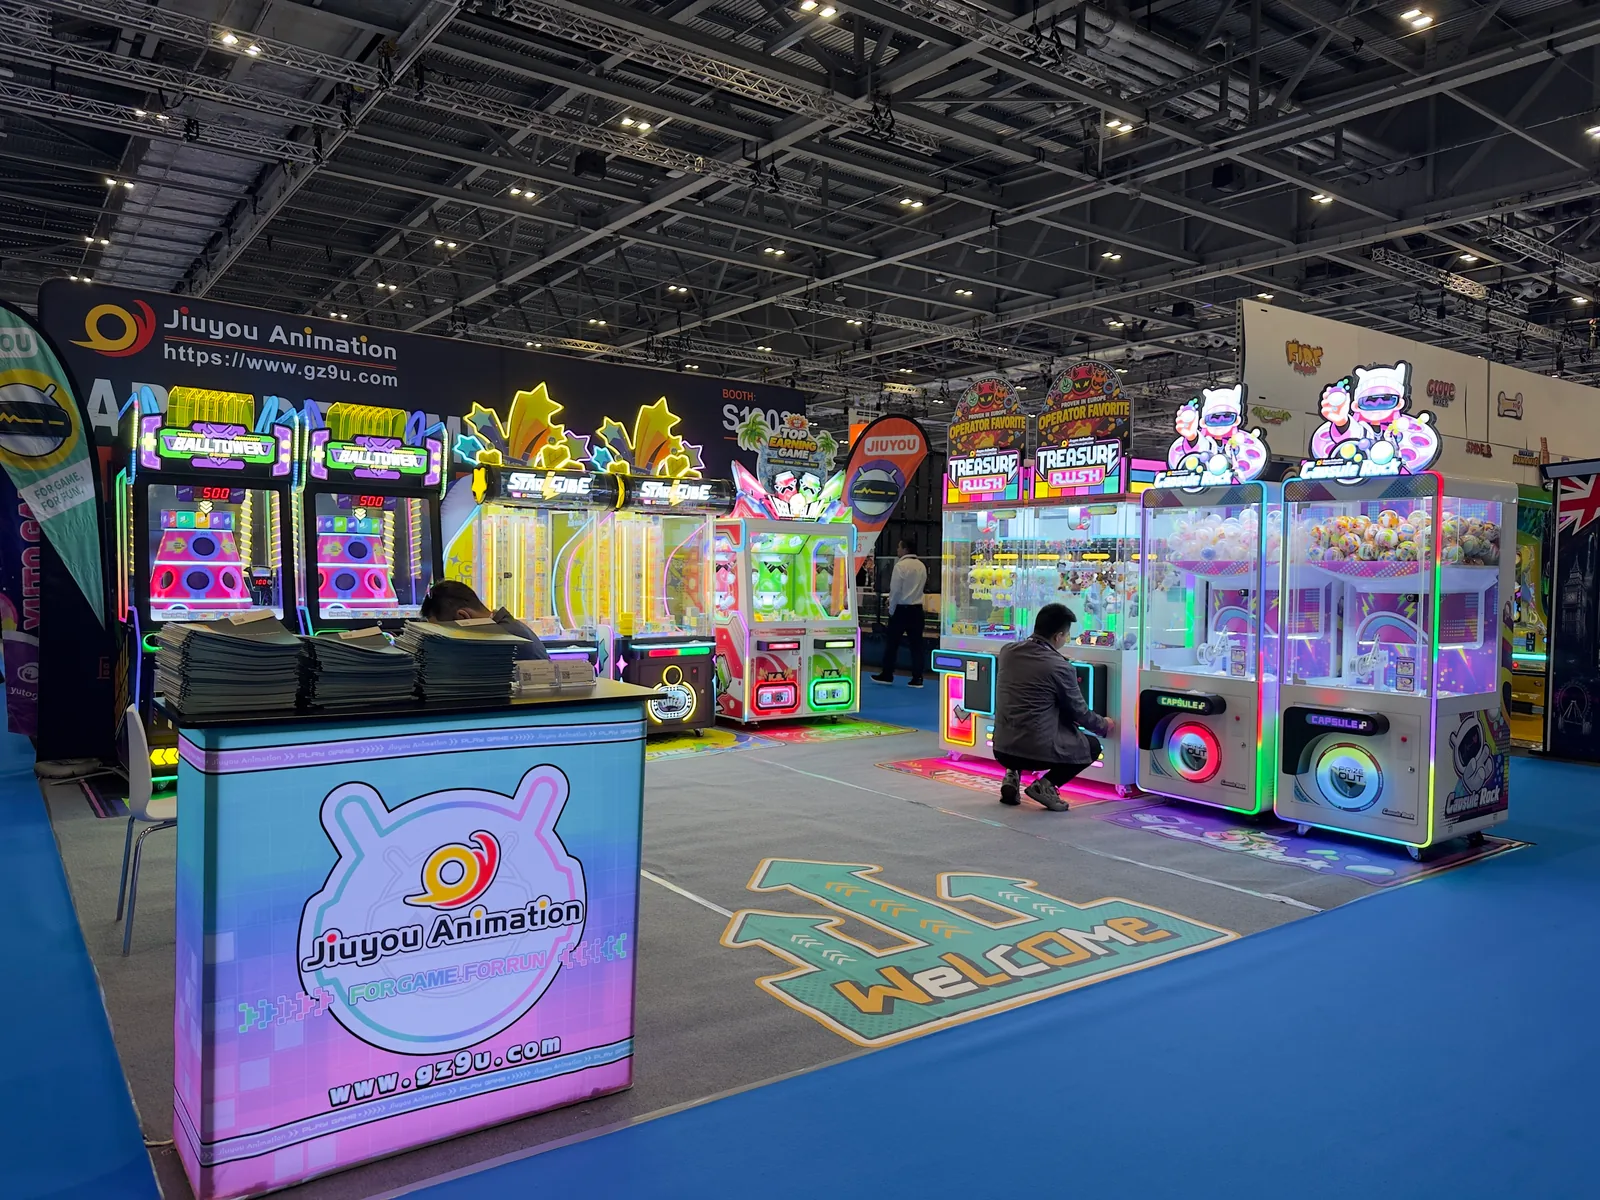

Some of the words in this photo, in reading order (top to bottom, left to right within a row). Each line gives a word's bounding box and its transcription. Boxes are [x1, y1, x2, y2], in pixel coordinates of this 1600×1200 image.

[164, 306, 258, 340] Jiuyou
[268, 325, 397, 361] Animation
[163, 342, 398, 388] https://www.gz9u.com
[722, 388, 756, 401] BOOTH:
[1060, 400, 1081, 409] PROVEN
[1087, 394, 1107, 403] EUROPE
[968, 412, 985, 420] PROVEN
[990, 409, 1007, 417] EUROPE
[1038, 405, 1086, 430] OPERATOR
[1087, 401, 1130, 418] FAVORITE
[781, 428, 808, 440] TOP
[949, 419, 990, 440] OPERATOR
[991, 416, 1026, 430] FAVORITE
[769, 437, 817, 451] EARNING
[866, 439, 917, 453] JIUYOU
[778, 449, 810, 459] GAME
[1037, 442, 1120, 476] TREASURE
[949, 453, 1018, 482] TREASURE
[962, 477, 1003, 492] RUSH
[1052, 469, 1100, 485] RUSH
[34, 484, 54, 500] FOR
[53, 471, 85, 491] GAME,
[202, 487, 230, 499] 500
[40, 495, 62, 512] FOR
[61, 486, 84, 504] FUN.
[359, 495, 385, 507] 500
[1161, 697, 1198, 709] CAPSULE
[1311, 715, 1358, 729] CAPSULE
[211, 755, 240, 767] Jiuyou
[241, 753, 282, 765] Animation
[1187, 748, 1207, 757] OUT
[1338, 772, 1364, 782] OUT
[1445, 791, 1480, 816] Capsule
[1479, 785, 1501, 805] Rock
[304, 930, 421, 969] Jiuyou
[430, 898, 582, 945] Animation
[328, 1036, 562, 1107] www.gz9u.com
[246, 1133, 287, 1149] Animation
